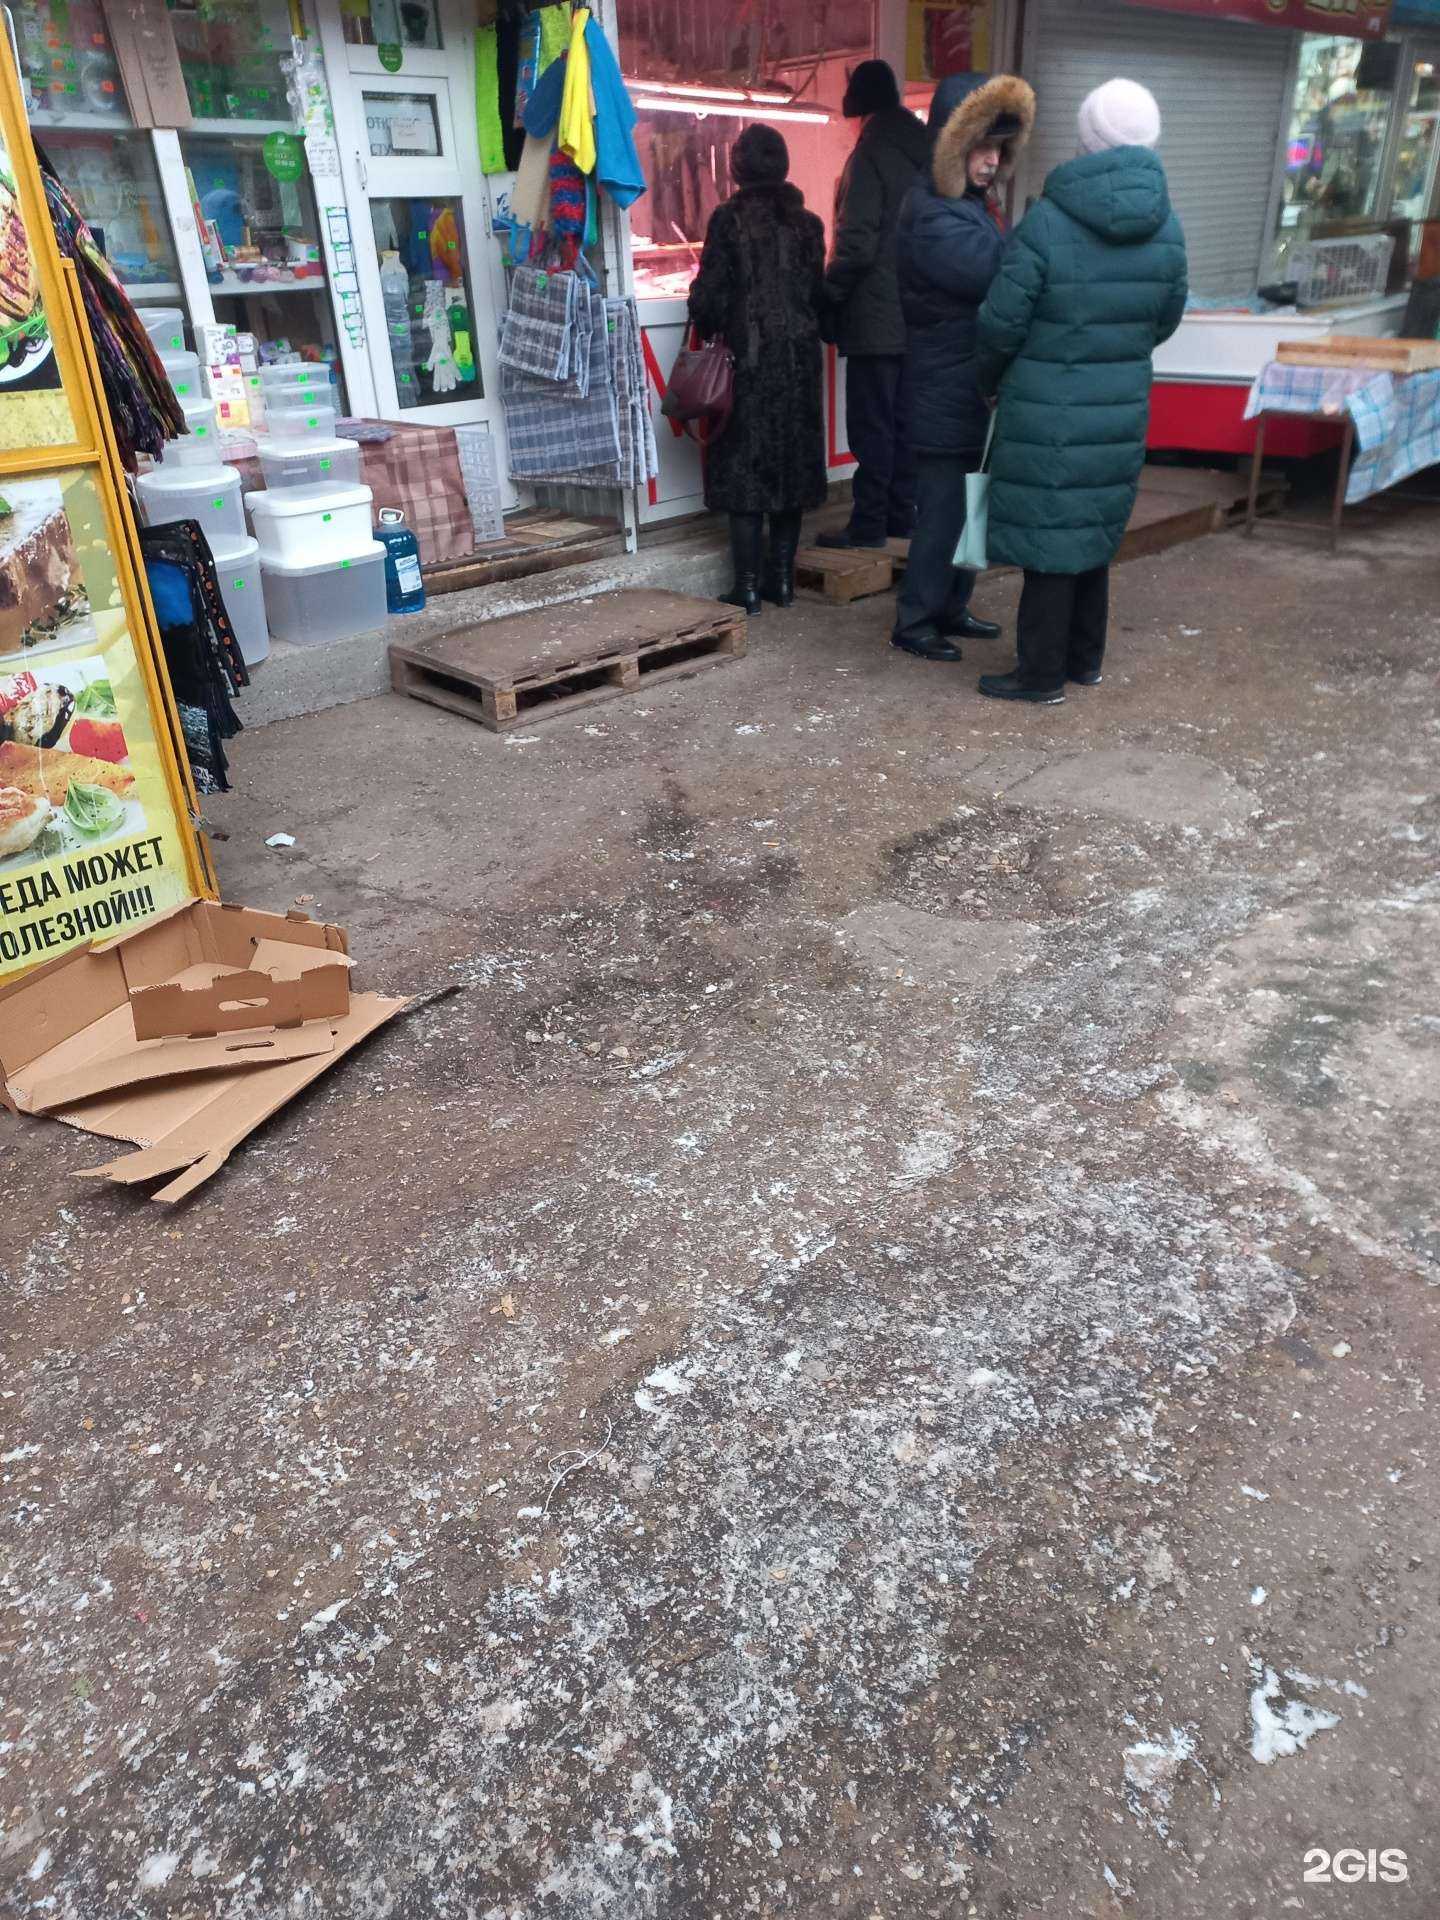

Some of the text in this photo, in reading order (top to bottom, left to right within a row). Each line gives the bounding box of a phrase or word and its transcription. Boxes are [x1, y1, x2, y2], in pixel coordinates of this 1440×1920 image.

[0, 836, 164, 914] ЕДА МОЖЕТ
[0, 885, 156, 964] ОЛЕЗНОЙ!!!
